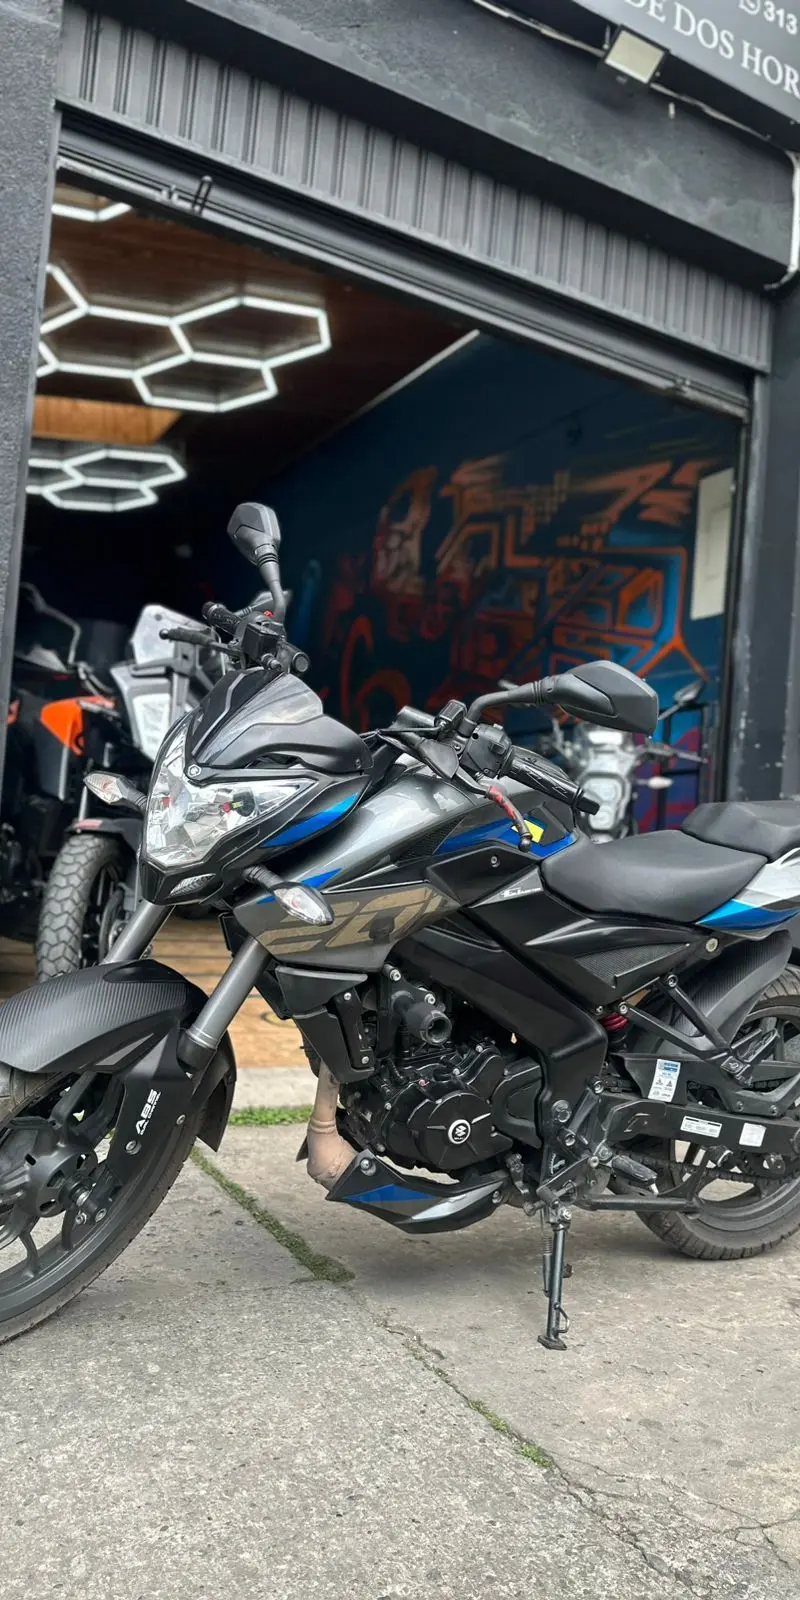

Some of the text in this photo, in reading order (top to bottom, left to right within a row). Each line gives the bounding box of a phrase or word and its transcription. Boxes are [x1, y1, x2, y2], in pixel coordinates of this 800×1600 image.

[763, 0, 798, 36] 313
[623, 0, 800, 100] E DOS HOR
[135, 1088, 158, 1135] ABS
